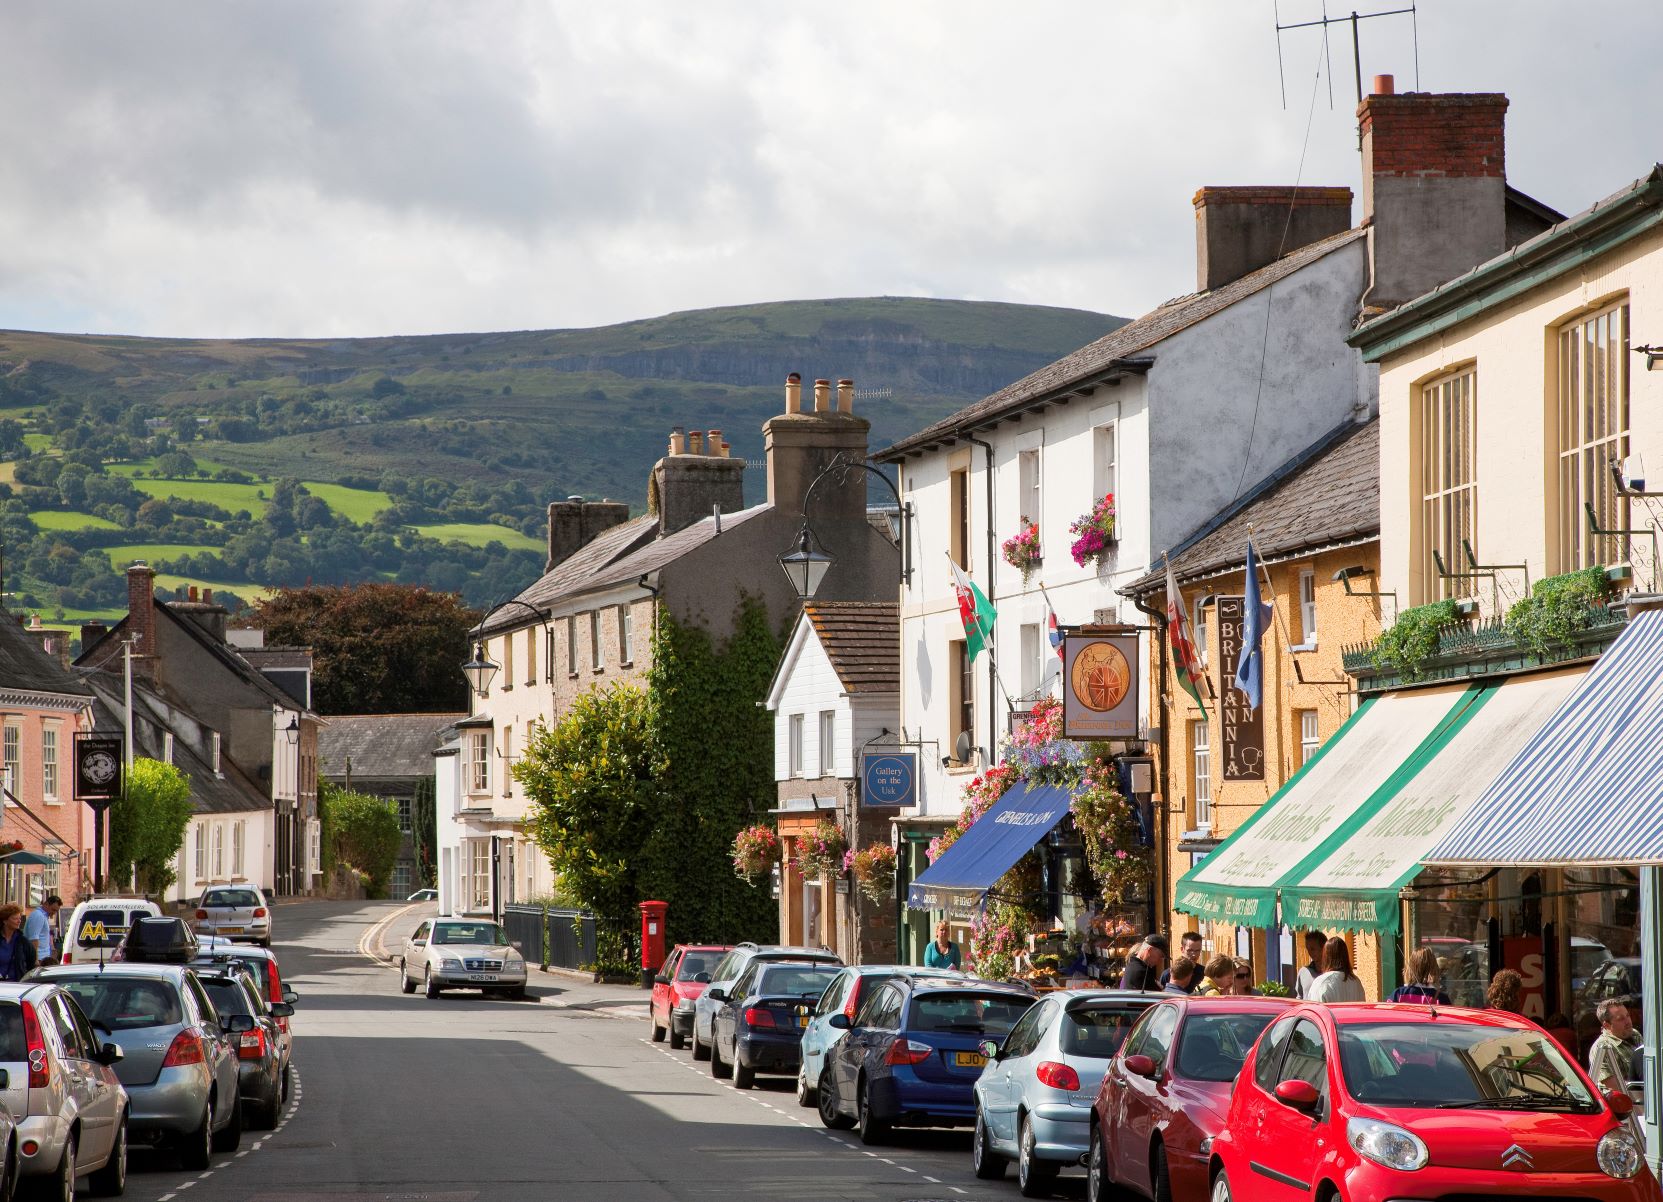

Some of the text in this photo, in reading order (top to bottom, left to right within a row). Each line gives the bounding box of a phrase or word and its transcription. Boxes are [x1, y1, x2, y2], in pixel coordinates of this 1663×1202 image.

[1221, 622, 1240, 777] BRITANNIA
[875, 767, 903, 777] Gallery
[890, 777, 901, 785] the
[881, 786, 896, 795] Usk
[79, 921, 109, 940] AA
